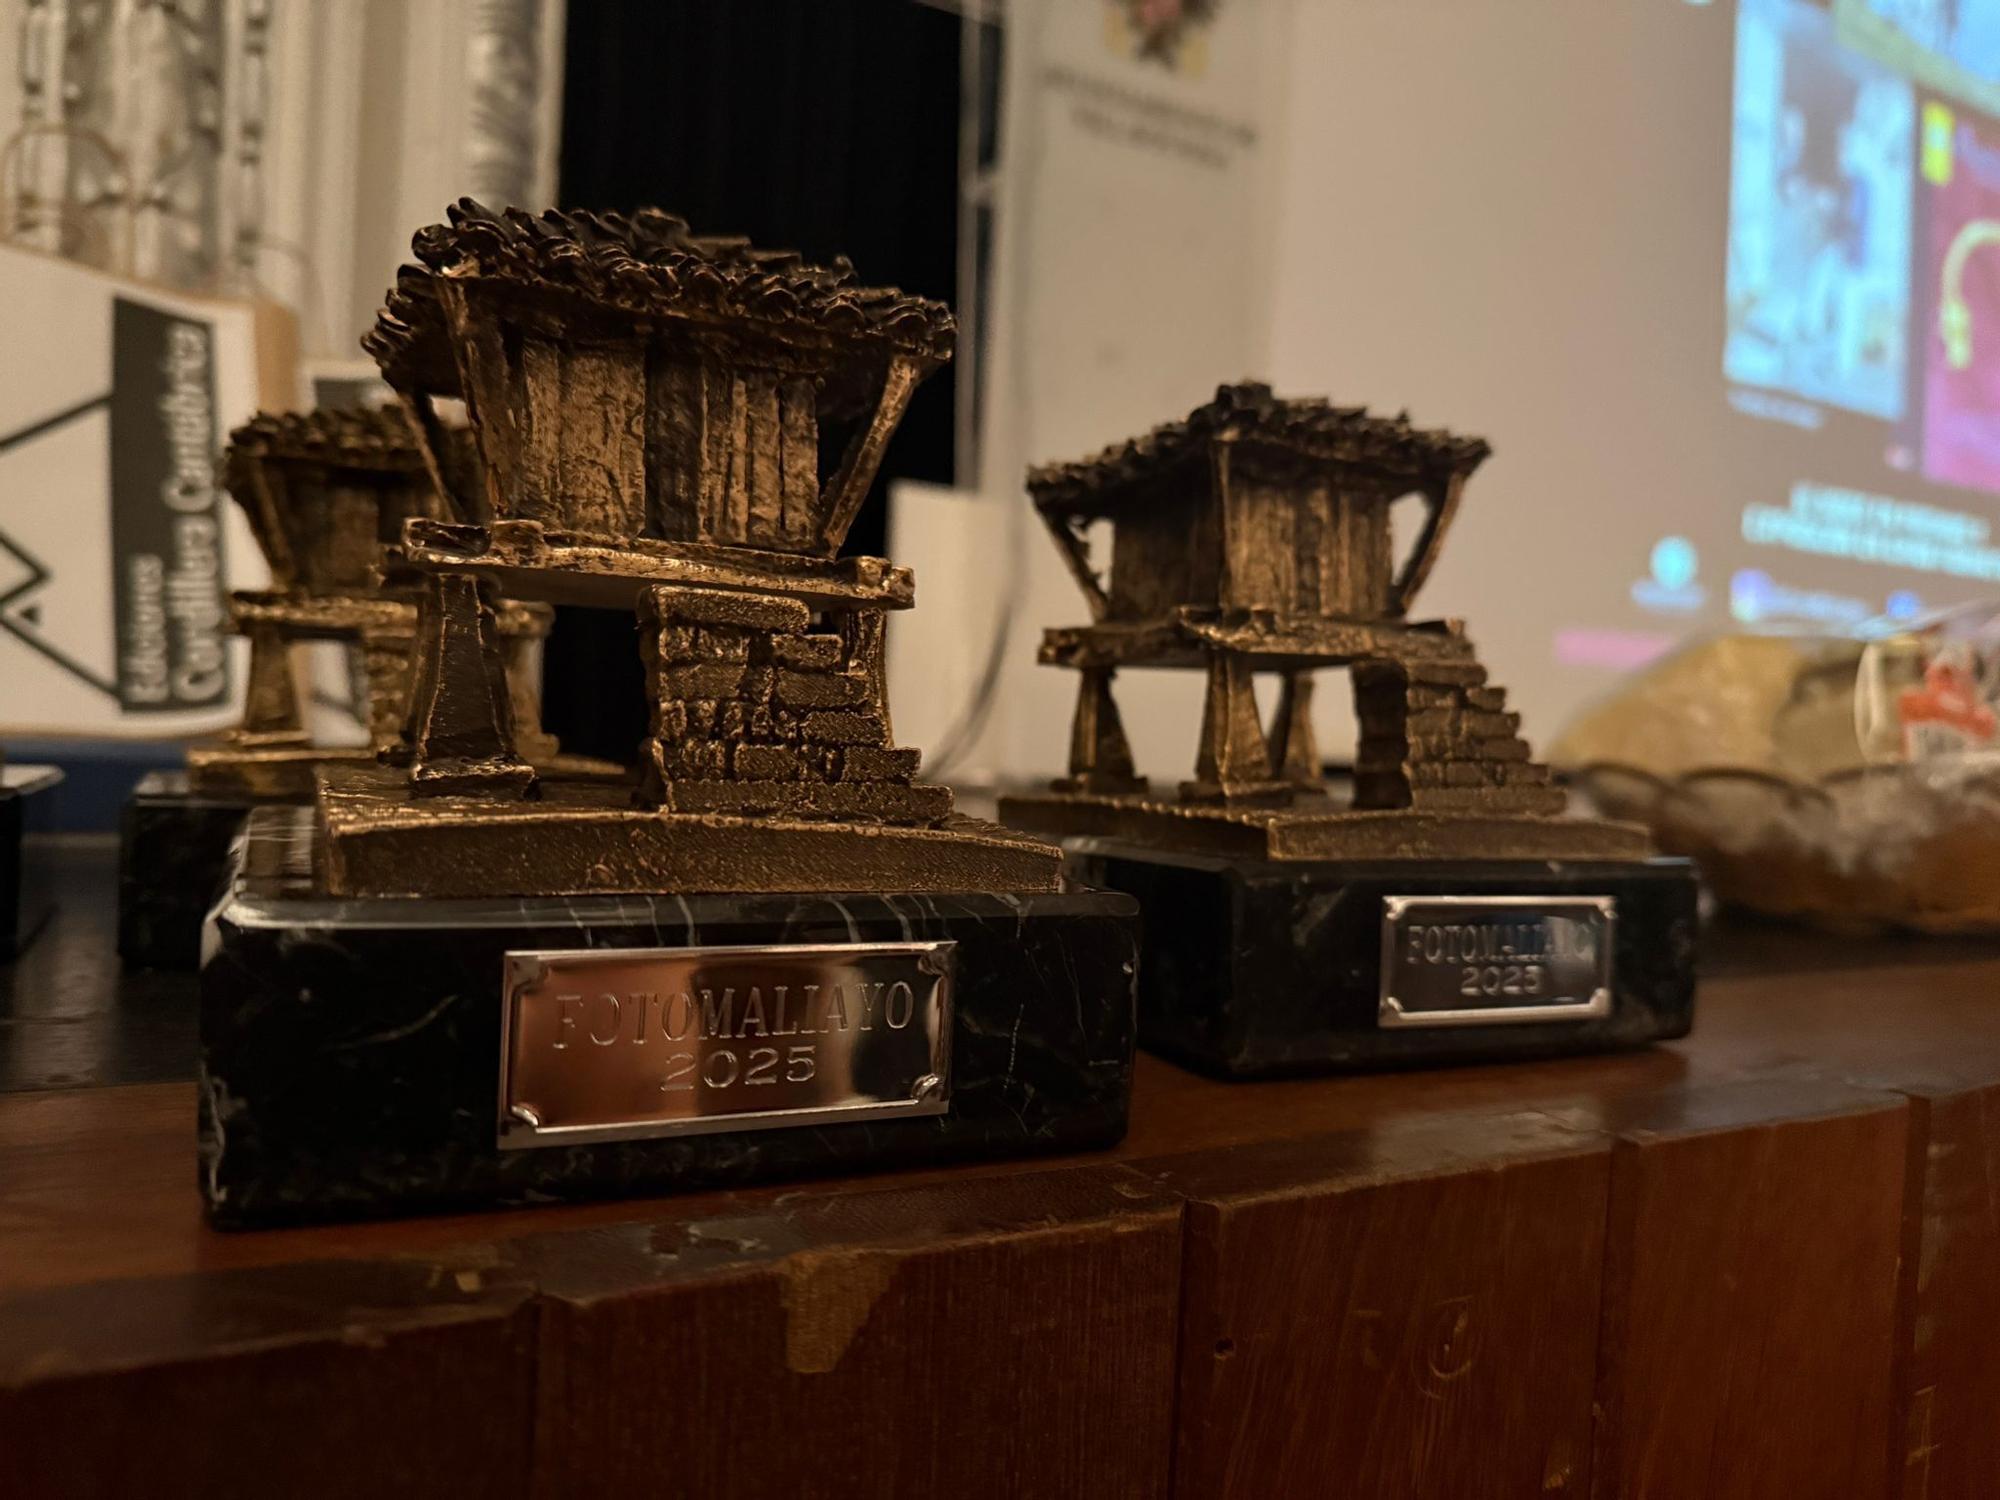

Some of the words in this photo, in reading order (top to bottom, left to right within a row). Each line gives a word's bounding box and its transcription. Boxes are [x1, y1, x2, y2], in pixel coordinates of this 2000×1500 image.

[167, 515, 226, 702] Cordillera
[552, 979, 915, 1050] FOTOMALIAYO
[659, 1044, 818, 1093] 2025
